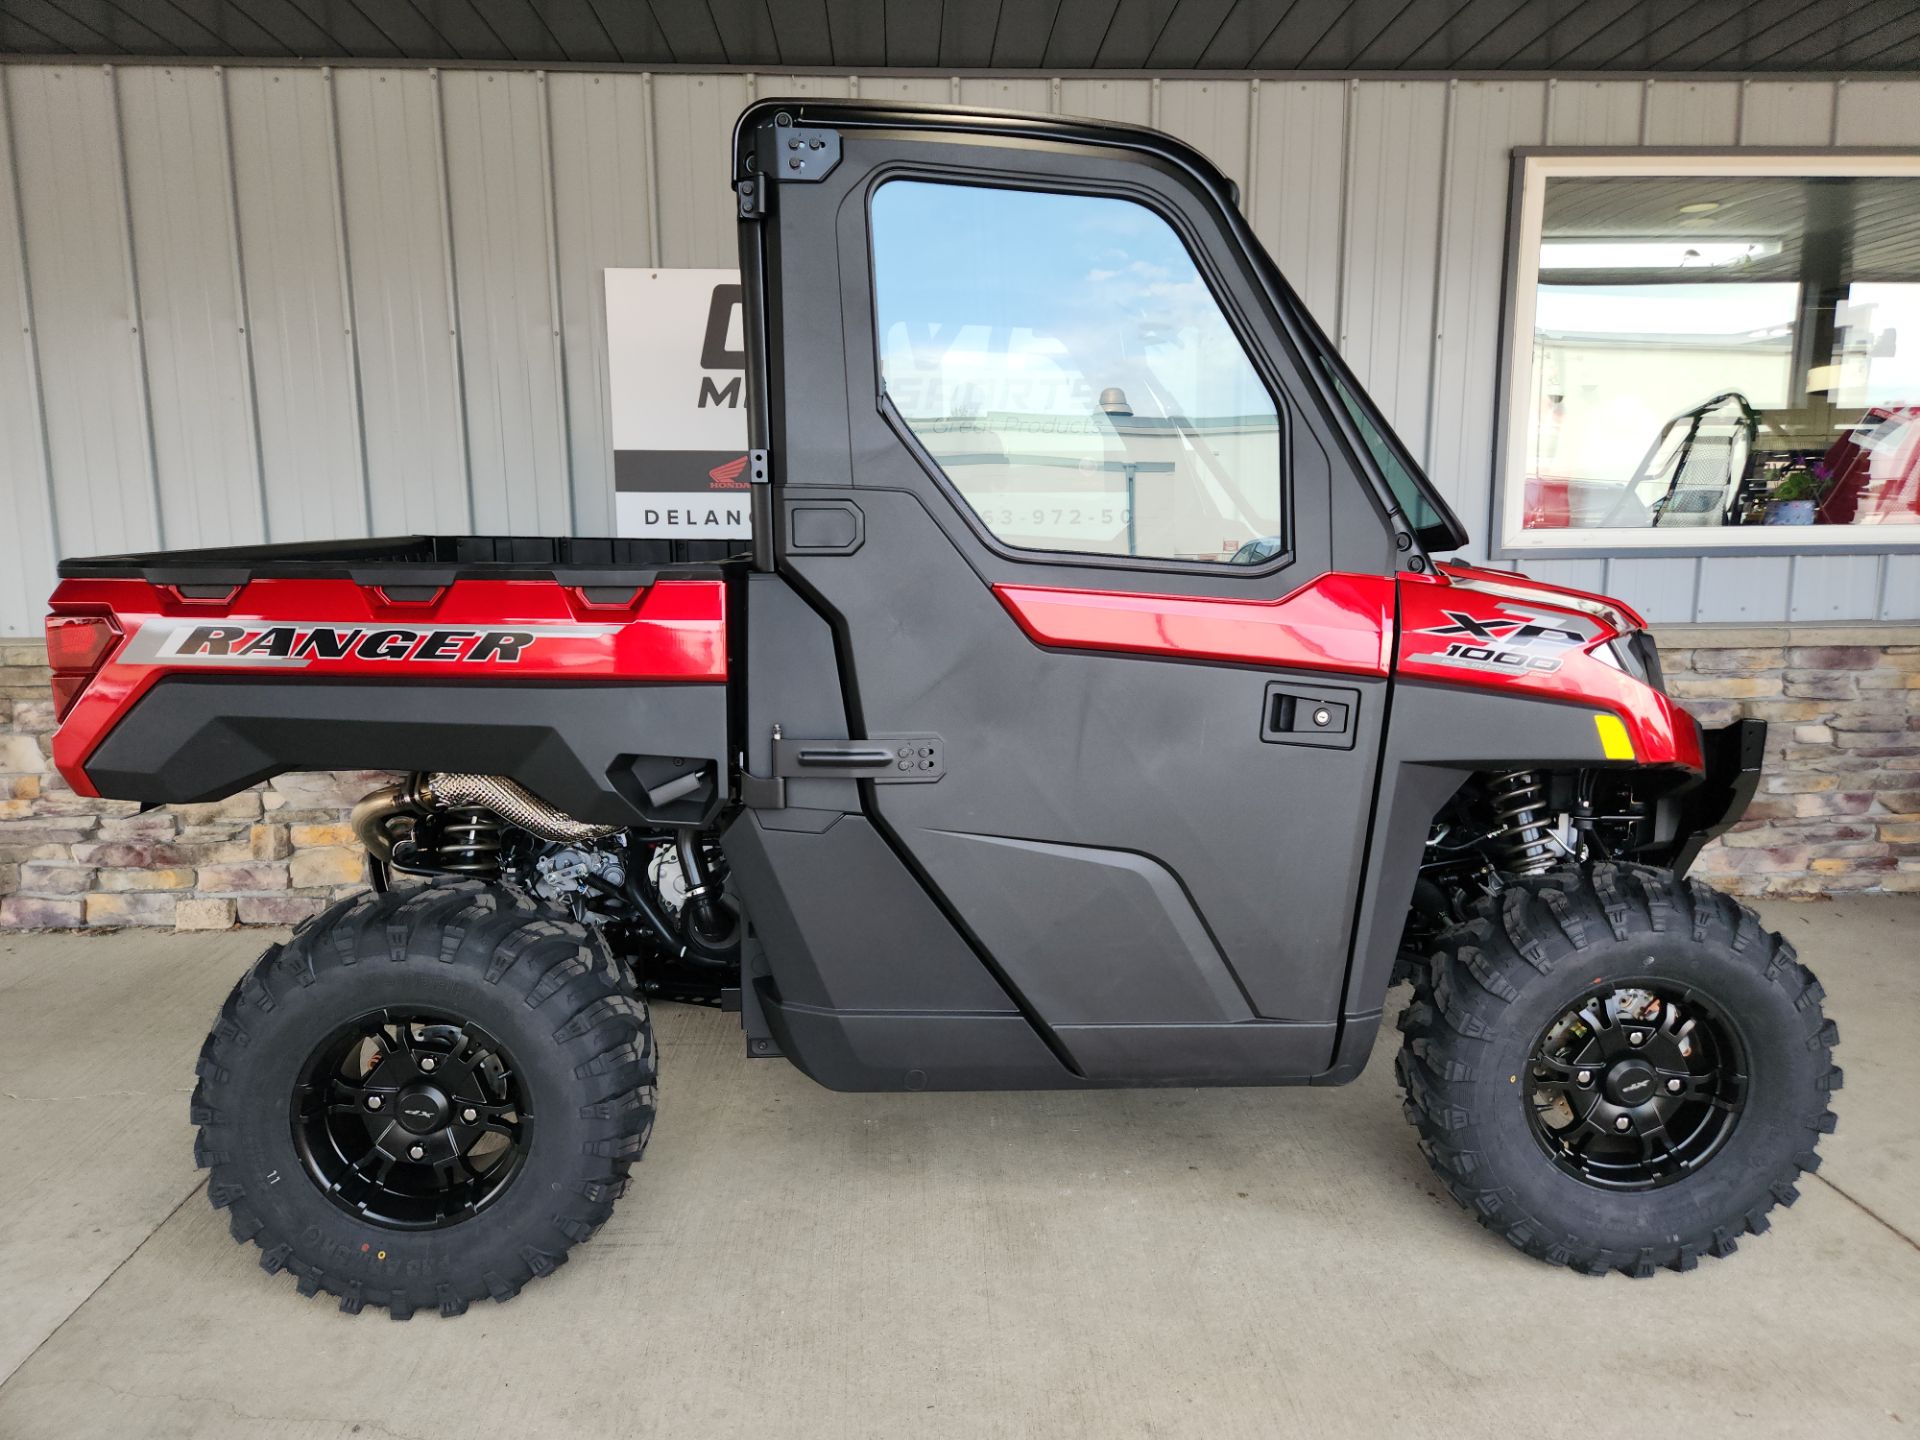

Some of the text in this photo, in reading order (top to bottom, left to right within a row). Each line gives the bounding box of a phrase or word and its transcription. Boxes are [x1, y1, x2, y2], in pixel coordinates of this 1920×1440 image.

[932, 416, 1102, 435] Great Products
[644, 509, 753, 525] DELAN
[1418, 610, 1588, 647] XP
[175, 625, 537, 663] RANGER
[1445, 644, 1564, 673] 1000
